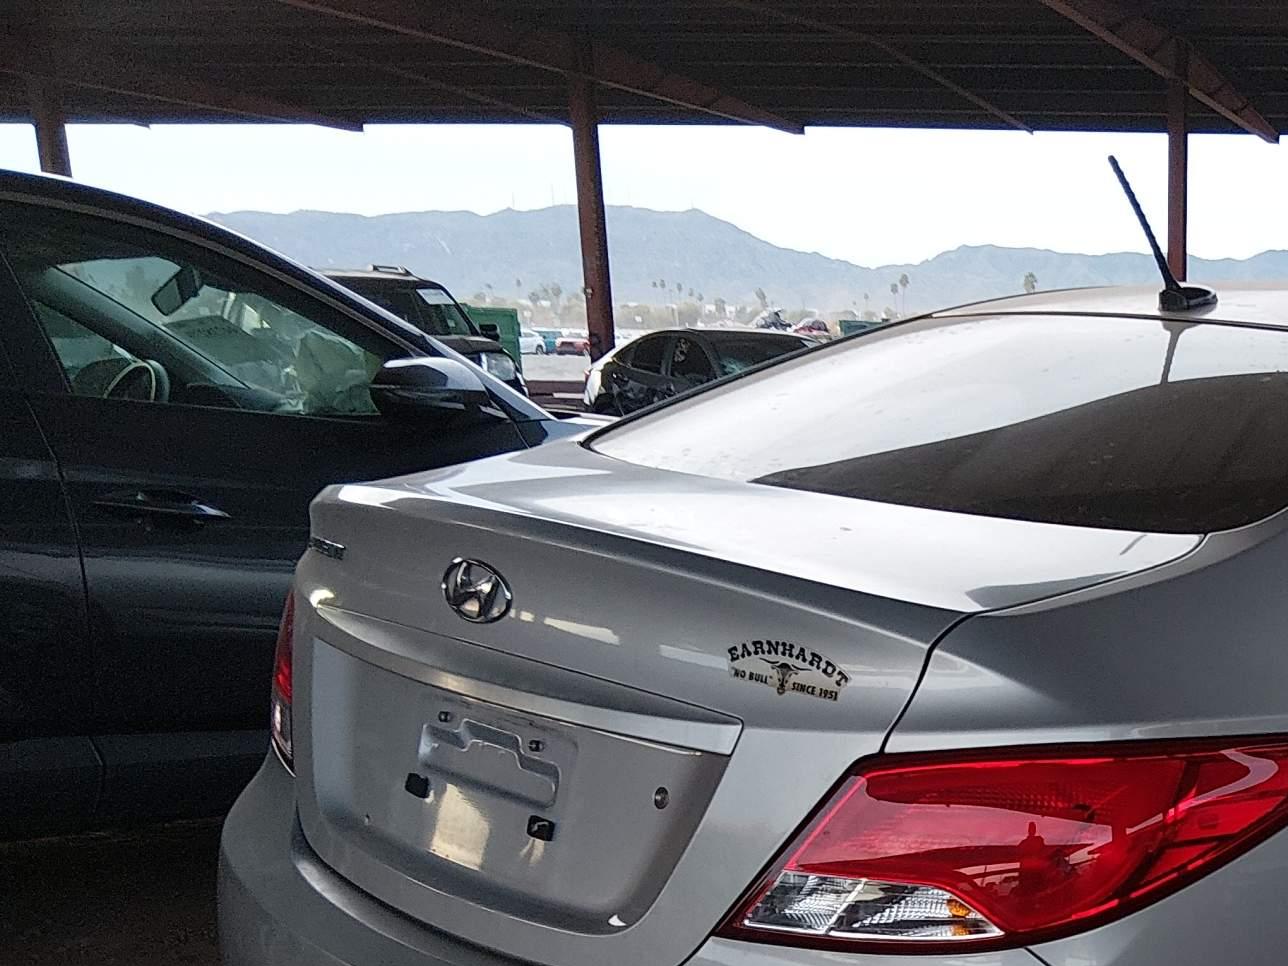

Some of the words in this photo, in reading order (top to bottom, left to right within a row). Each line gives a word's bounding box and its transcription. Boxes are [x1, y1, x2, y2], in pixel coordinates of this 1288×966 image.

[728, 639, 850, 687] EARNHARDT
[791, 681, 817, 696] SINCE
[818, 687, 839, 702] 1951
